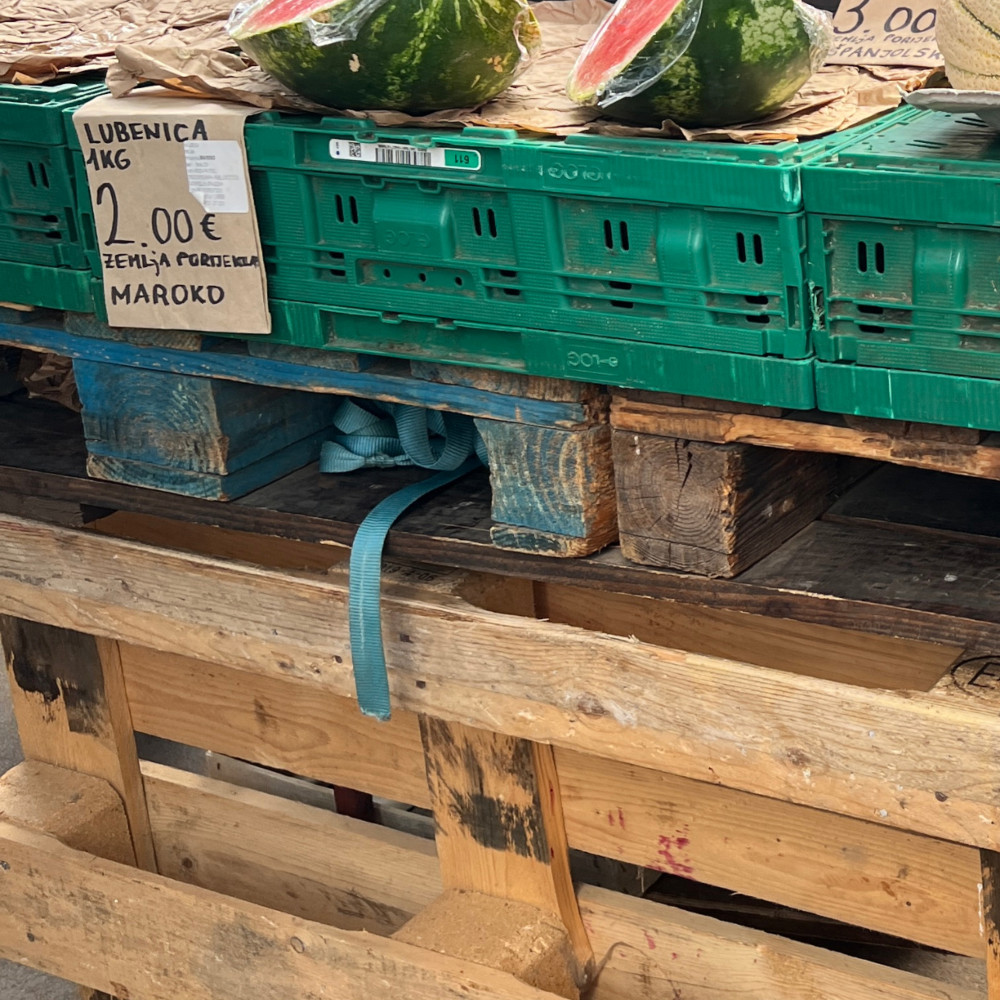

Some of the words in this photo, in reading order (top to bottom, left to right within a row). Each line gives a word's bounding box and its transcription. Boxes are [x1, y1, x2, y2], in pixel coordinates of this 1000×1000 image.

[834, 34, 875, 45] EMLJA
[827, 43, 945, 60] ŠPANJOLSK
[83, 119, 208, 144] LUBENICA
[86, 148, 131, 171] 1KG
[111, 283, 226, 307] MAROKO
